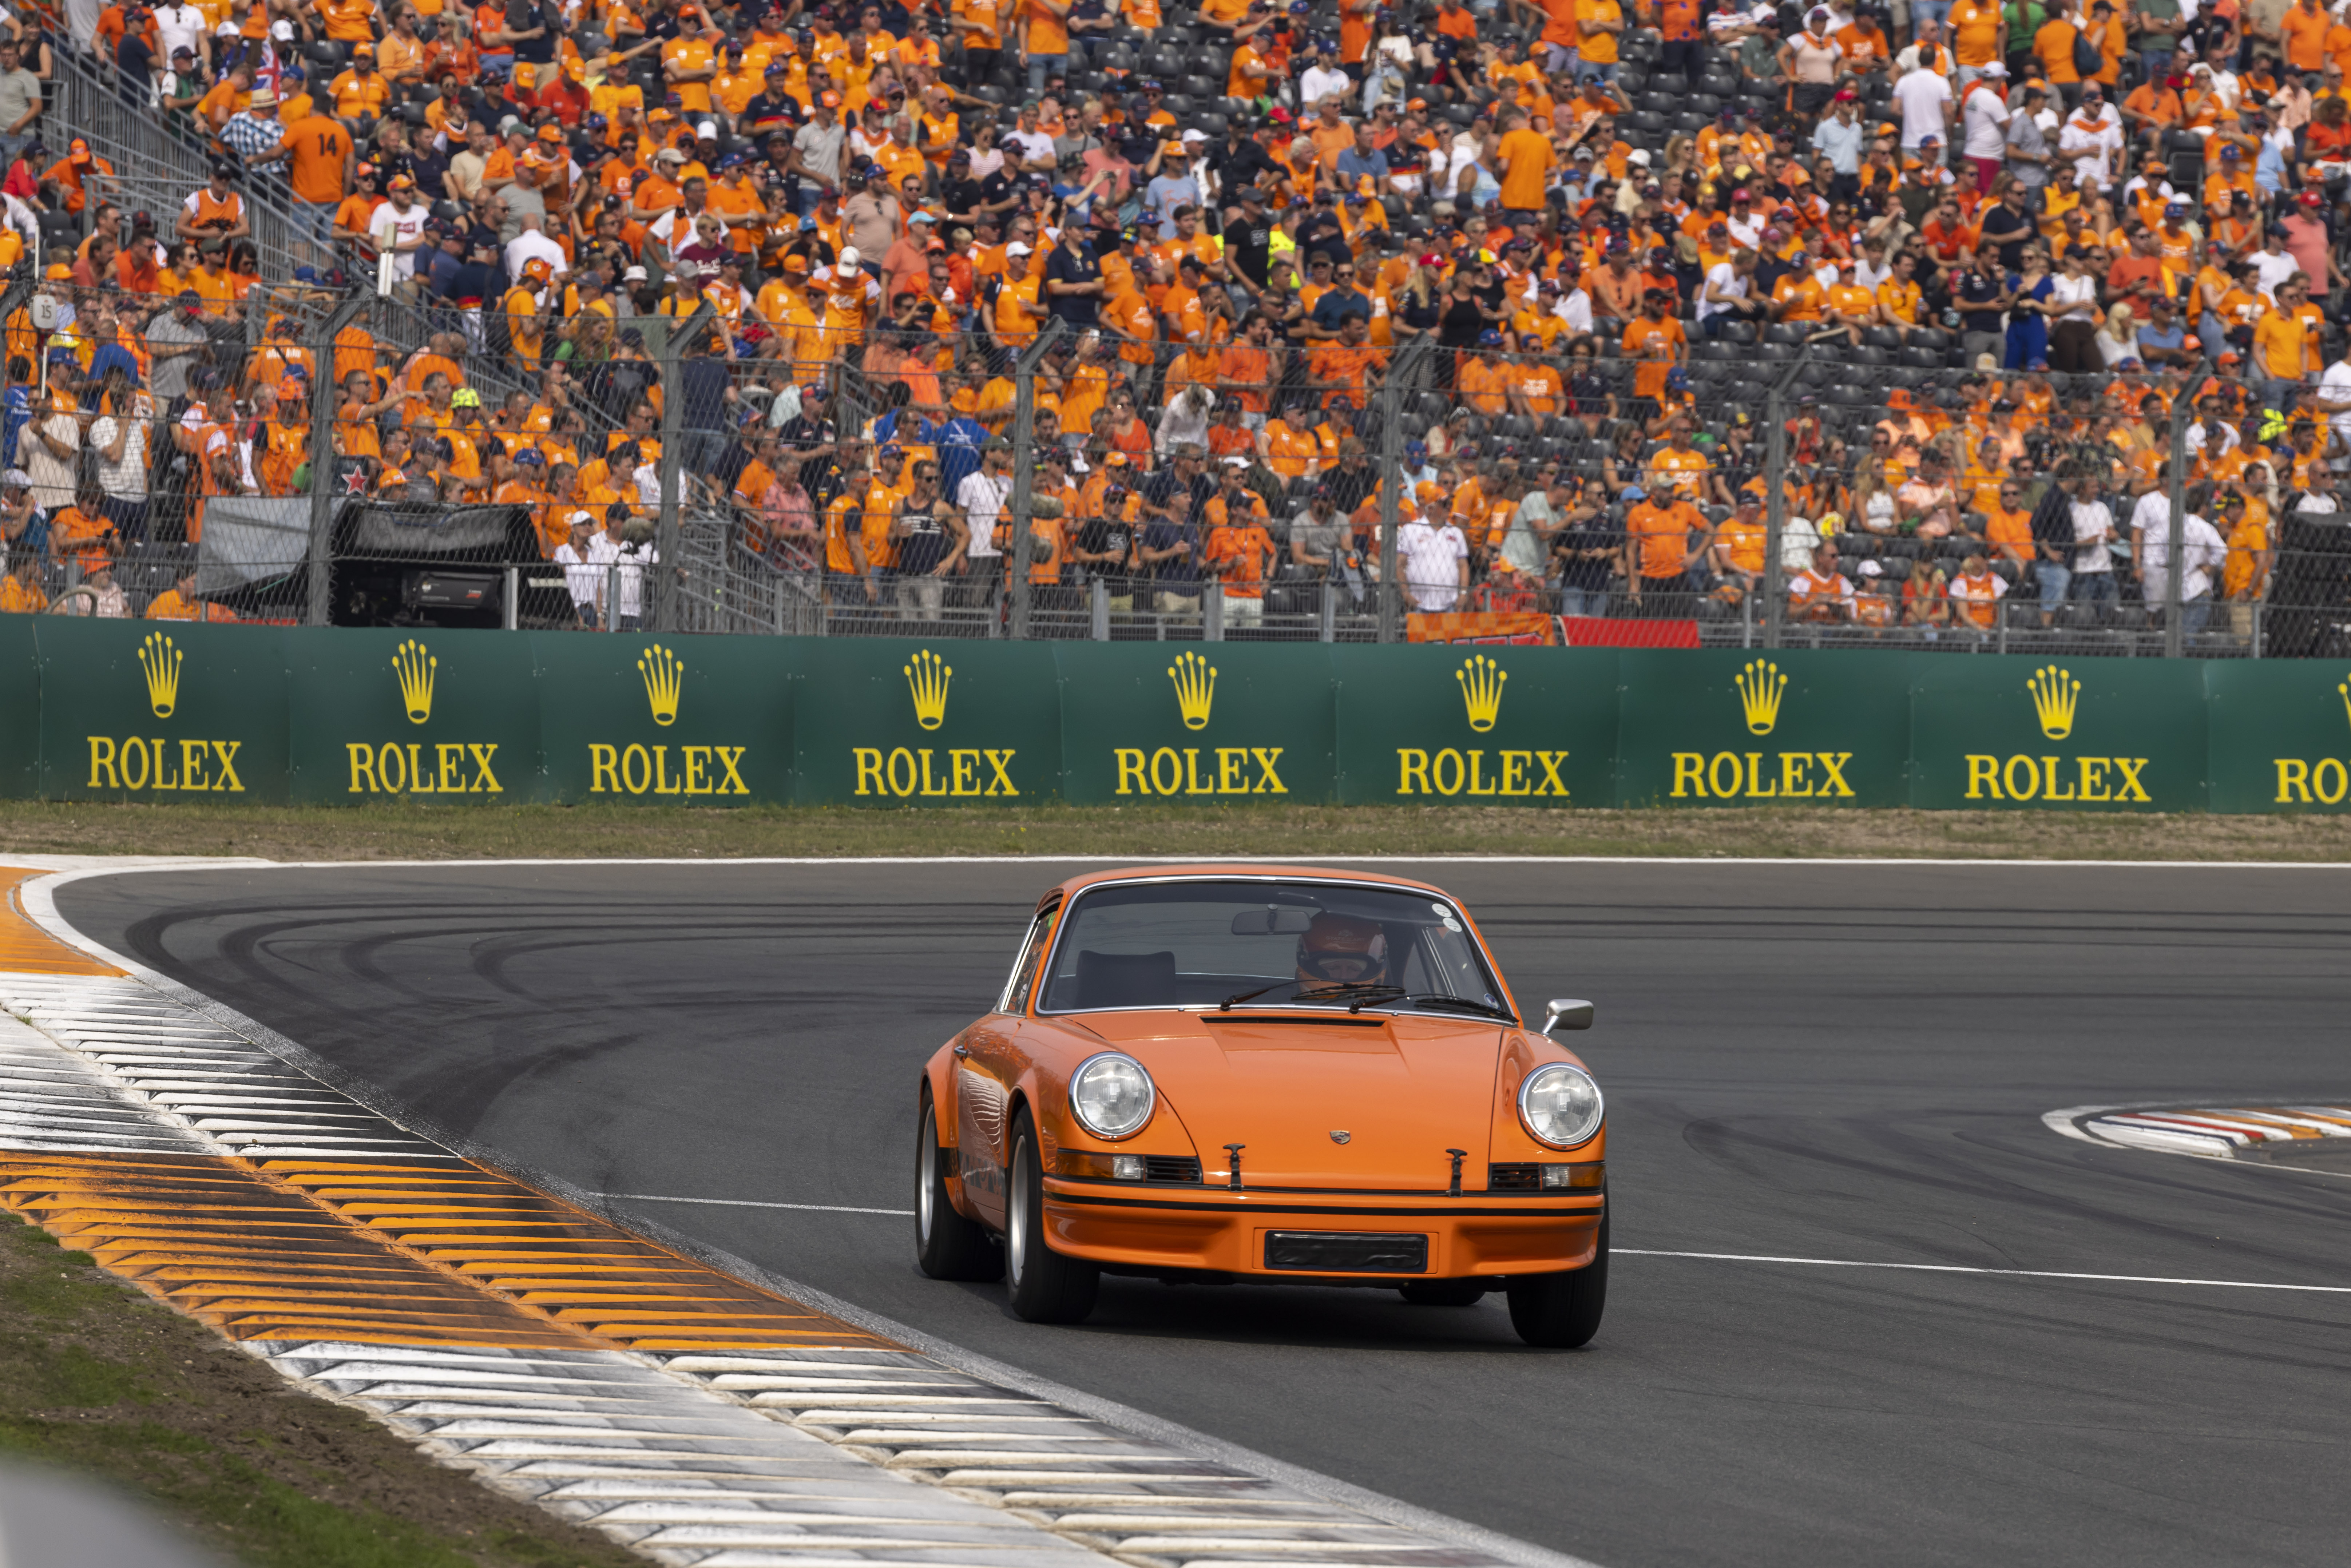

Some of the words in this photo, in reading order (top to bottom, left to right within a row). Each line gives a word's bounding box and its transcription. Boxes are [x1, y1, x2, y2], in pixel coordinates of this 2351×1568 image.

[318, 133, 337, 156] 14
[41, 305, 52, 319] 15
[87, 736, 246, 792] ROLEX
[345, 743, 504, 794] ROLEX
[588, 743, 750, 795] ROLEX
[852, 747, 1020, 798] ROLEX
[1113, 746, 1289, 796] ROLEX
[1396, 747, 1570, 797] ROLEX
[1669, 751, 1856, 799] ROLEX
[1964, 754, 2152, 802] ROLEX
[2273, 757, 2351, 805] RO
